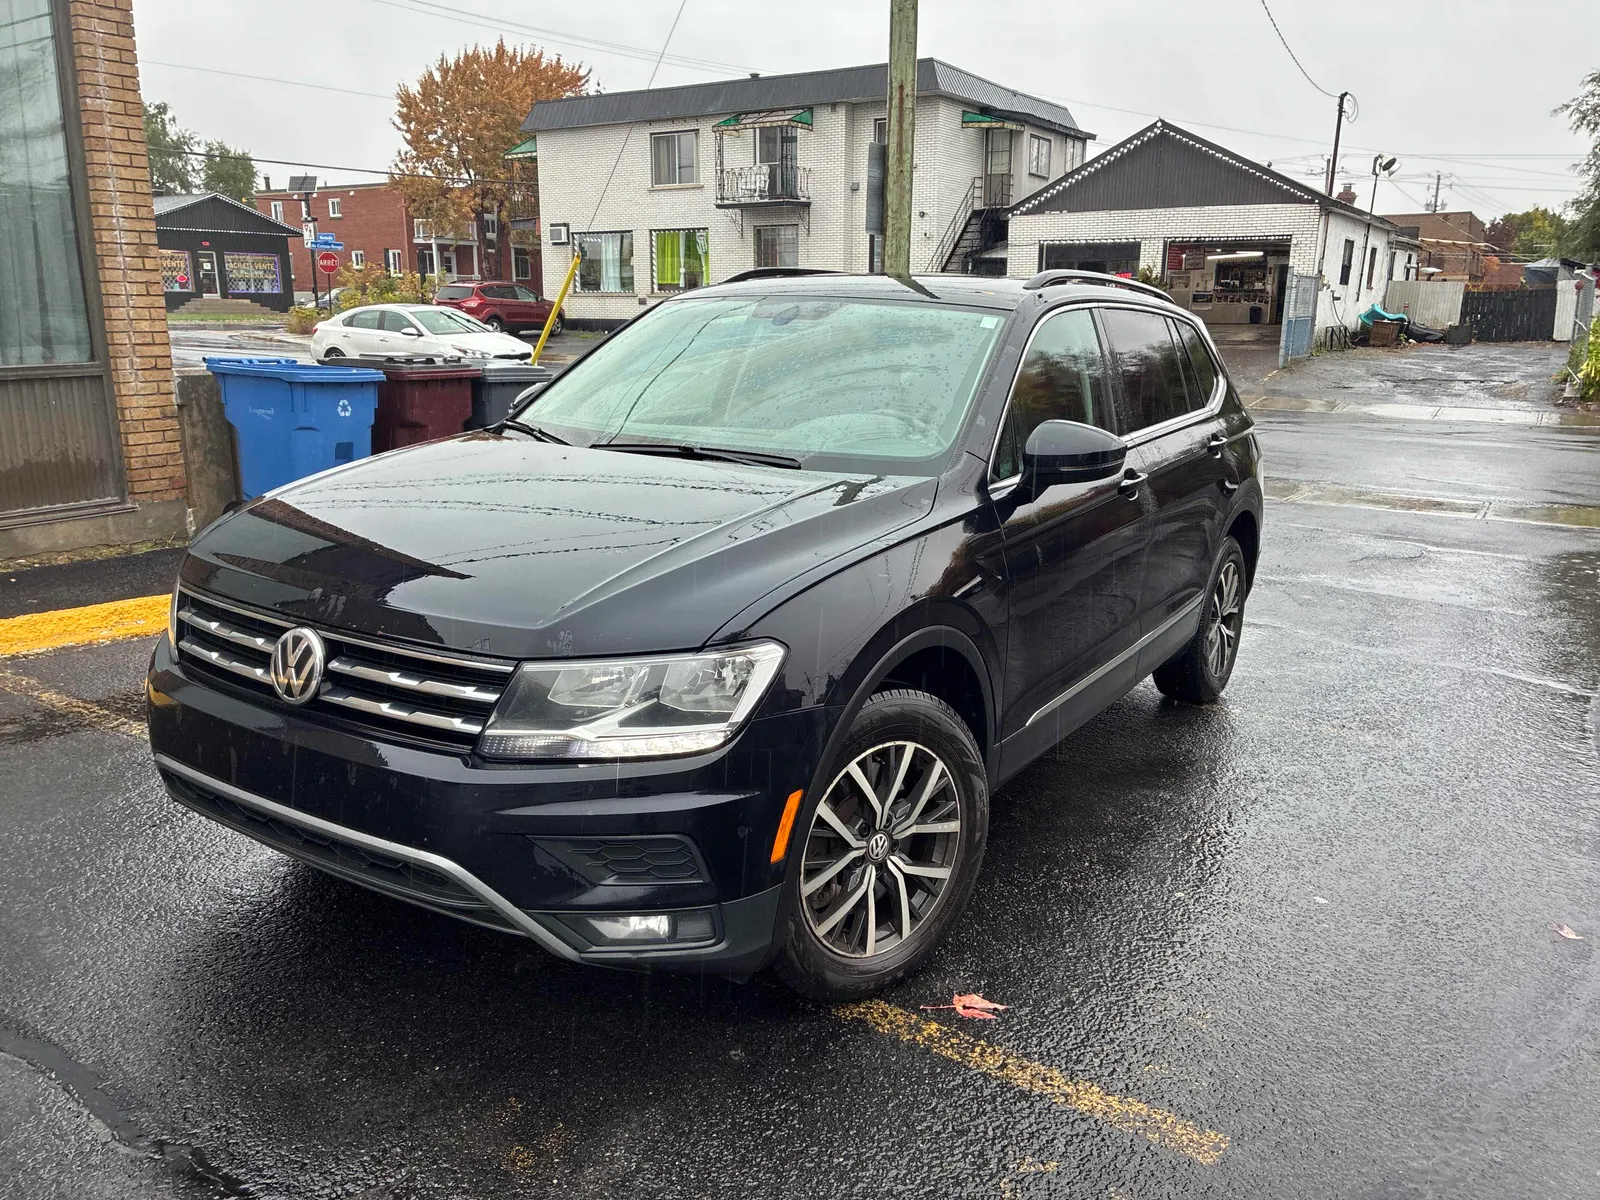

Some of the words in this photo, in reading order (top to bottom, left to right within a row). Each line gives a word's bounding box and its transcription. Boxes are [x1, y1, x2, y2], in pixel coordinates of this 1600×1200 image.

[161, 260, 186, 268] VENTE
[229, 262, 250, 270] ACHAT
[320, 259, 338, 267] ARRÊT
